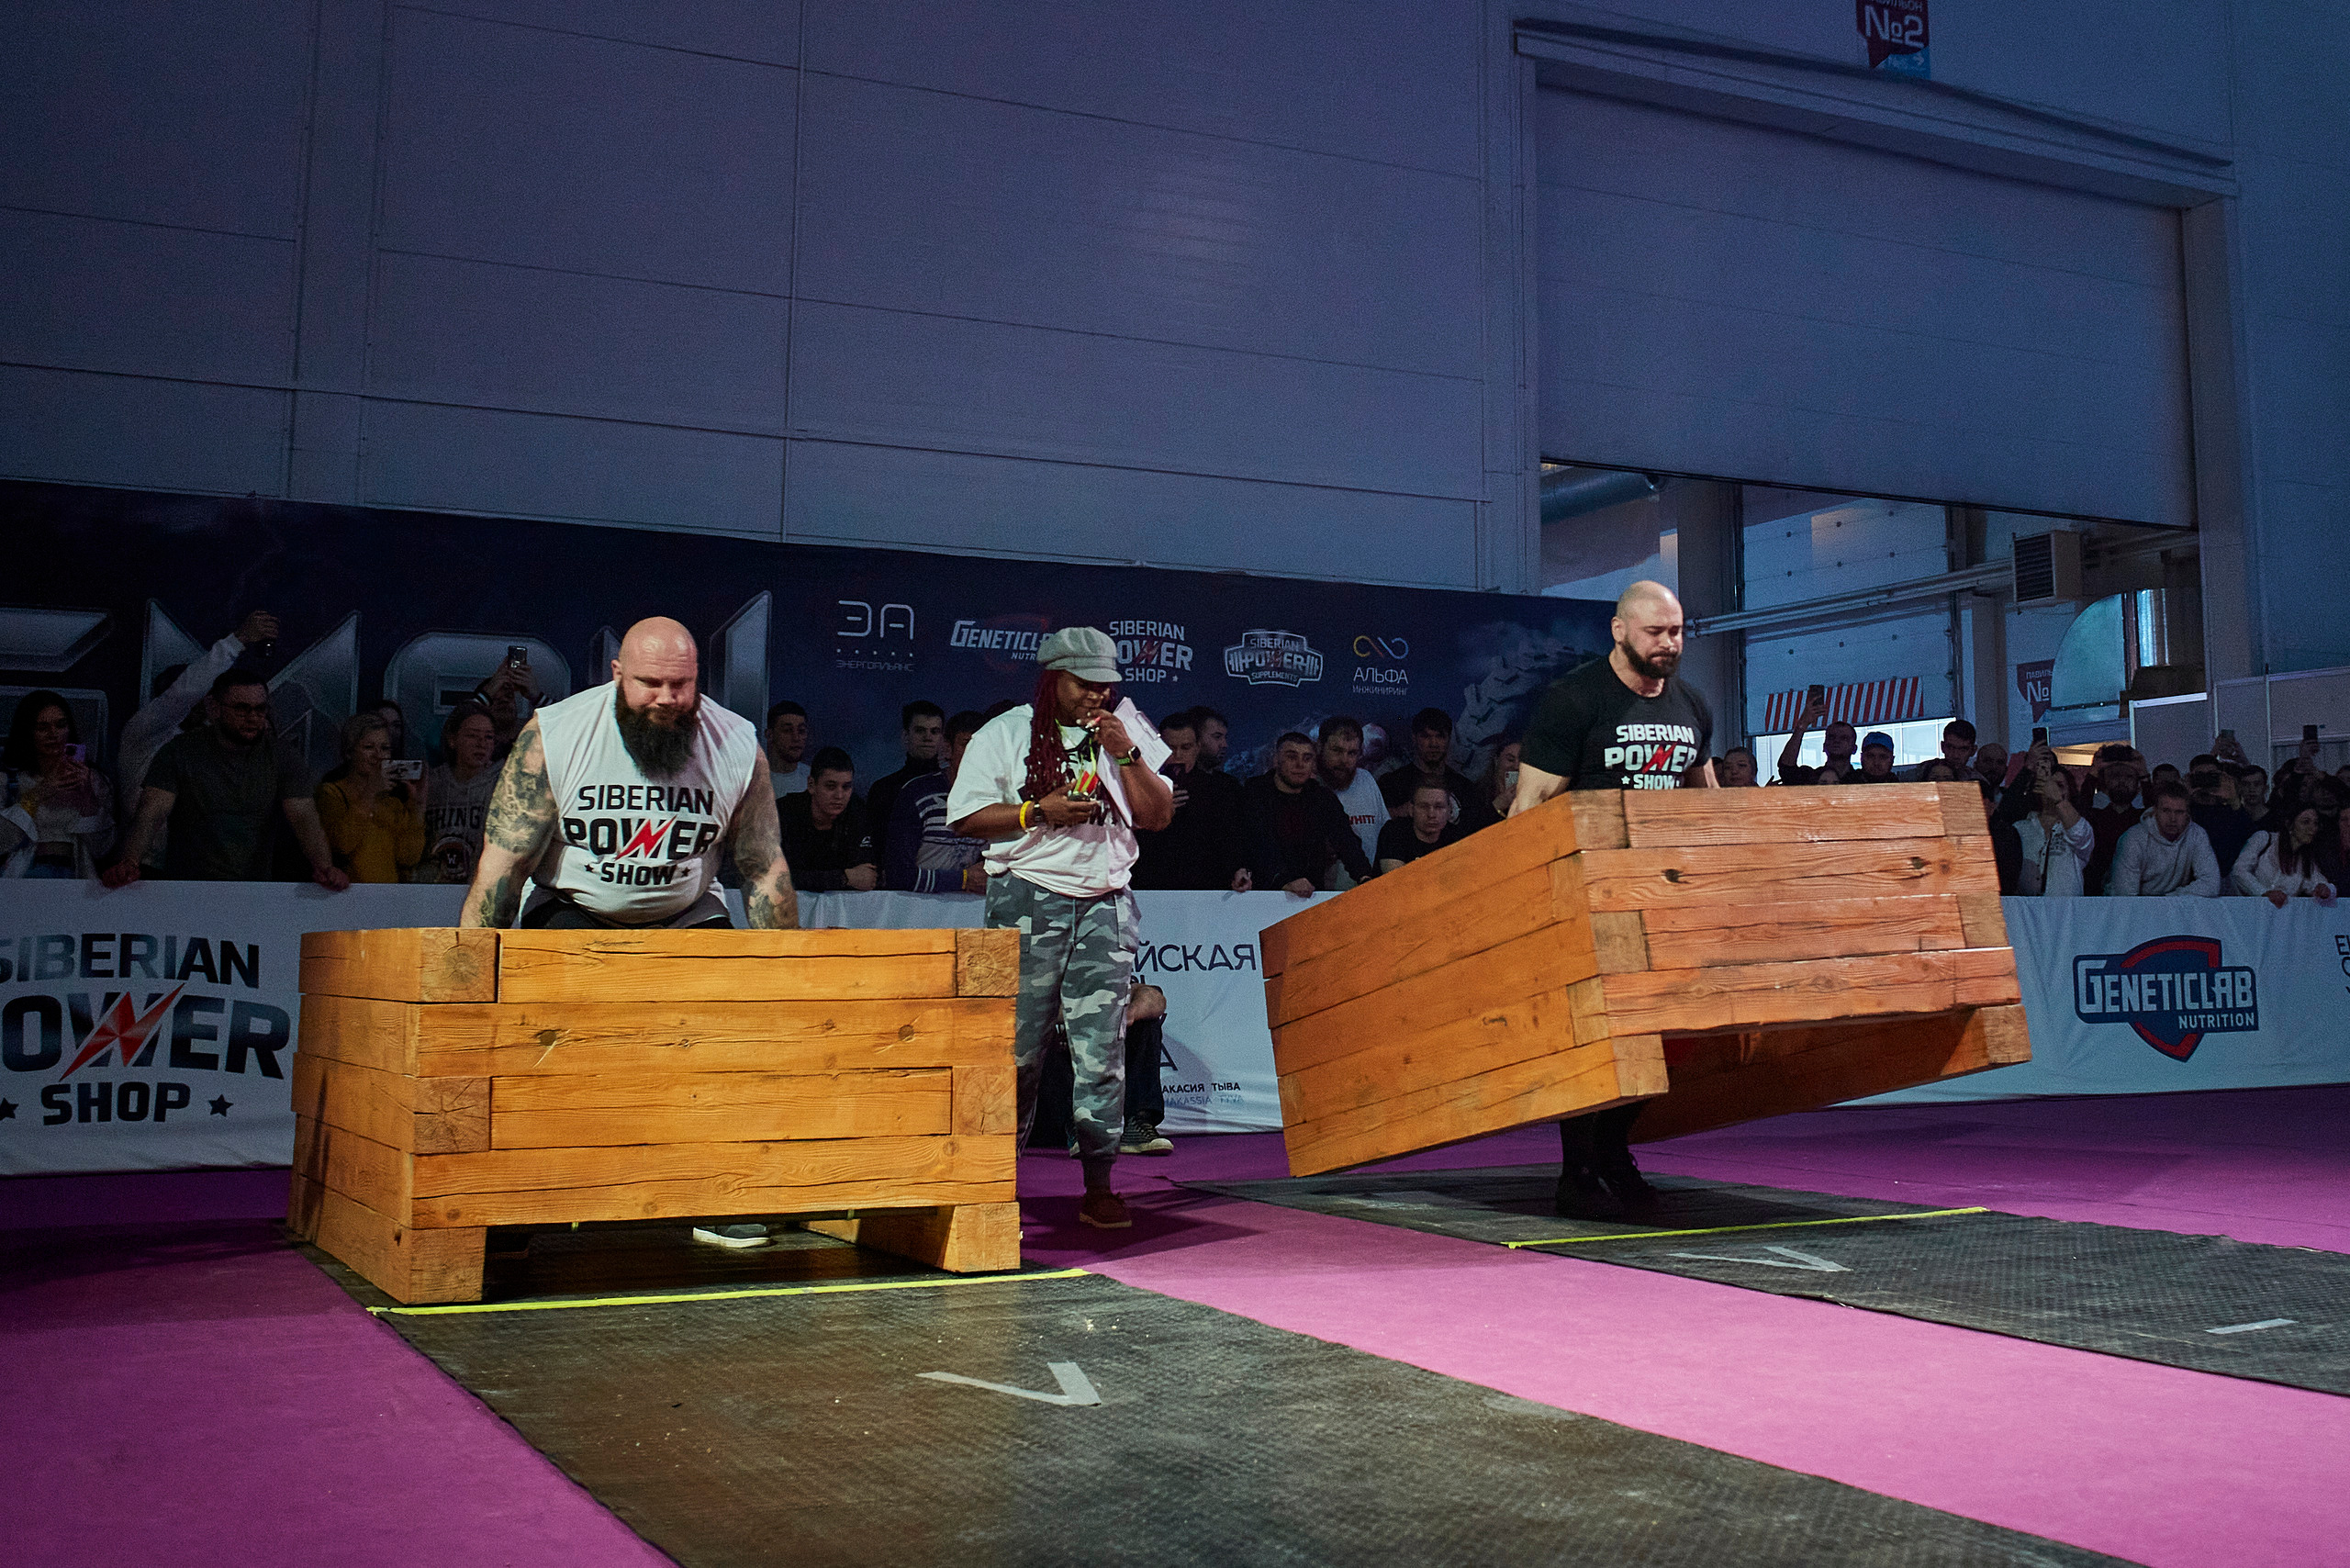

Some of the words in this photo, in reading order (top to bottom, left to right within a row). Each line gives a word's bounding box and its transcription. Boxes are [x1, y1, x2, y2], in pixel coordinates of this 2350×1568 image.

[950, 620, 1055, 652] GENETICL
[1109, 620, 1185, 642] SIBERIAN
[1116, 639, 1193, 672] OWER
[1249, 637, 1300, 652] SIBERIAN
[1011, 653, 1037, 662] NUTR
[1244, 650, 1304, 672] POWER
[1125, 667, 1167, 683] SHOP
[1250, 670, 1299, 682] SUPPLEMENTS
[1352, 666, 1409, 685] АЛЬФА
[1616, 723, 1695, 745] SIBERIAN
[1604, 744, 1697, 772] POWER
[1633, 774, 1675, 790] SHOW
[577, 784, 713, 816] SIBERIAN
[563, 816, 721, 860] POWER
[600, 862, 678, 886] SHOW
[1131, 940, 1257, 972] ЙСКАЯ
[2077, 959, 2255, 1014] GENETICLAB
[2178, 1013, 2255, 1029] NUTRITION
[2, 991, 291, 1081] OWER
[1162, 1083, 1205, 1093] АКАСИЯ
[1211, 1082, 1241, 1092] ТЫВА
[40, 1081, 191, 1126] SHOP
